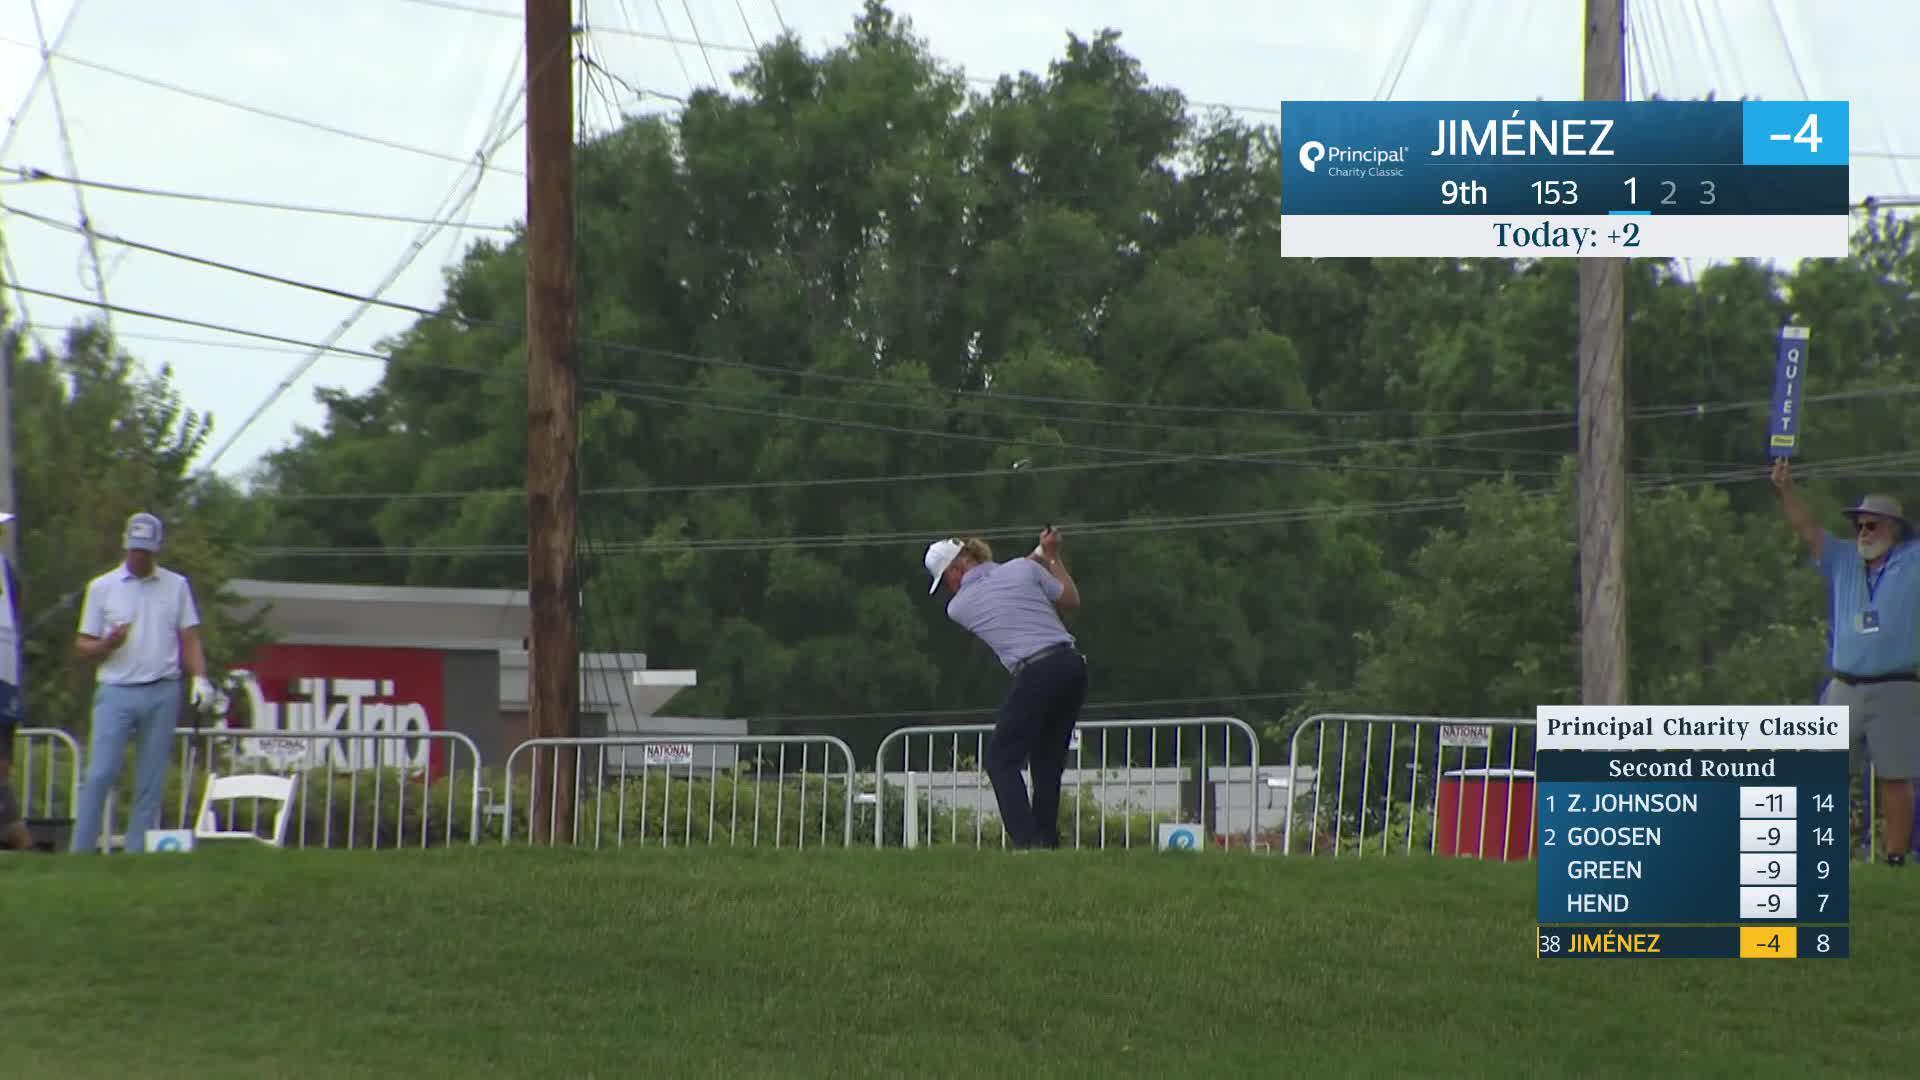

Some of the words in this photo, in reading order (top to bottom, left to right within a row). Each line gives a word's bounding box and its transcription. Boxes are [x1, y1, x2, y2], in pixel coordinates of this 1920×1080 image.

[1781, 348, 1800, 431] QUIET
[1442, 726, 1489, 738] NATIONAL
[647, 744, 690, 756] NATIONAL
